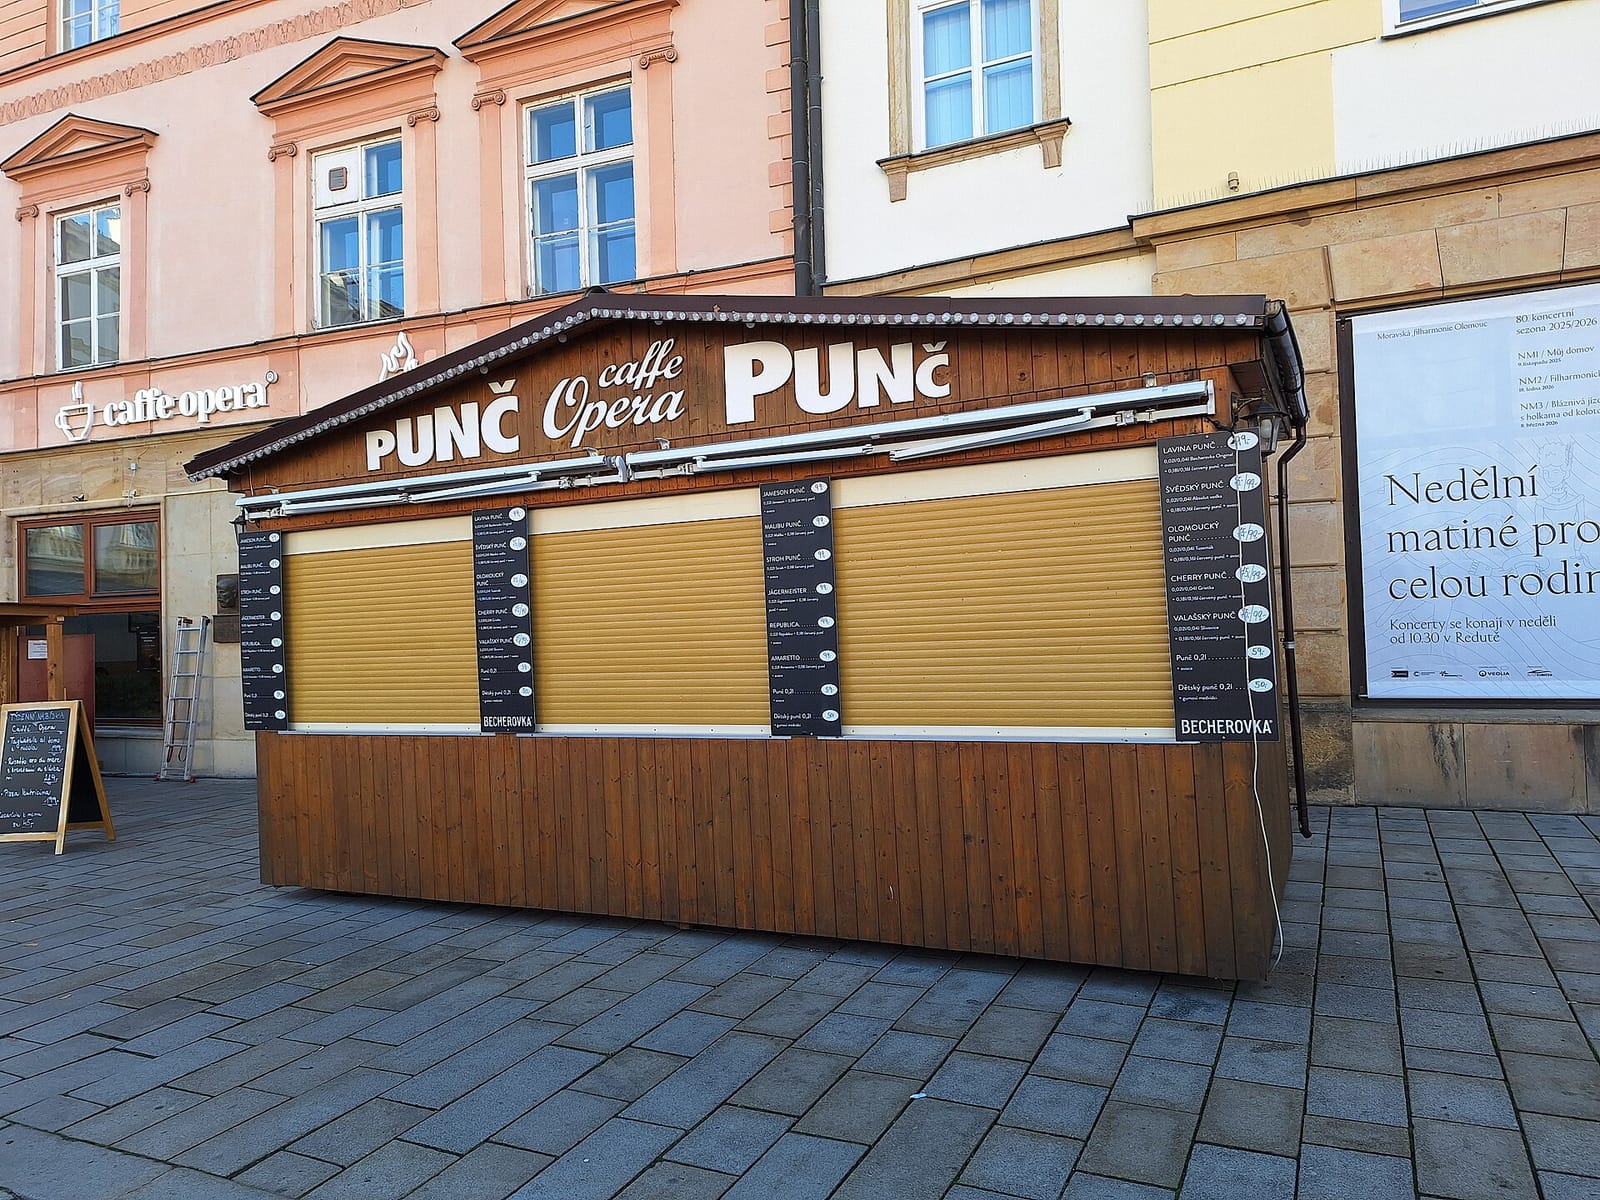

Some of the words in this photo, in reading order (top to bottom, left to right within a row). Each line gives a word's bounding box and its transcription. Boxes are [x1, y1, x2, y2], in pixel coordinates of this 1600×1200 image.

[1531, 308, 1575, 322] koncertní
[1377, 330, 1411, 340] Moravská
[1454, 321, 1489, 331] Olomouc
[1516, 325, 1546, 335] sezona
[1549, 317, 1598, 331] 2025/2026
[1566, 345, 1595, 355] domov
[598, 338, 684, 391] caffe
[723, 340, 951, 425] PUNČ
[1519, 376, 1542, 386] NM2
[103, 388, 177, 427] caffe
[1520, 402, 1543, 411] NM3
[1551, 398, 1585, 409] Bláznivá
[542, 376, 685, 448] Opera
[1526, 411, 1561, 421] holkama
[1562, 409, 1574, 418] od
[365, 379, 520, 472] PUNČ
[1163, 445, 1192, 454] LAVINA
[1193, 441, 1216, 450] PUNČ
[1165, 482, 1200, 494] ŠVÉDSKÝ
[1201, 480, 1224, 490] PUNČ
[1383, 464, 1538, 505] Nedělní
[763, 489, 789, 498] JAMESON
[790, 486, 806, 495] PUNČ
[764, 522, 785, 530] MALIBU
[785, 520, 802, 529] PUNČ
[1167, 521, 1220, 533] OLOMOUCKÝ
[1168, 533, 1191, 543] PUNČ
[1387, 515, 1519, 553] matiné
[1533, 520, 1600, 557] pro
[785, 553, 802, 561] PUNČ
[1171, 573, 1203, 582] CHERRY
[1204, 571, 1227, 580] PUNČ
[1388, 566, 1488, 600] celou
[1173, 611, 1212, 622] VALAŠSKÝ
[1213, 611, 1236, 620] PUNČ
[1390, 618, 1445, 632] Koncerty
[1450, 620, 1462, 629] se
[1465, 617, 1503, 630] konají
[1519, 615, 1556, 628] neděli
[1390, 633, 1406, 644] od
[1410, 633, 1440, 644] 10.30
[1443, 635, 1452, 643] v
[1455, 631, 1500, 643] Redutě
[1193, 653, 1207, 662] 0,2l
[1178, 683, 1202, 692] Dětský
[1219, 683, 1233, 691] 0,2l
[483, 716, 533, 727] BECHEROVKA
[1181, 719, 1272, 734] BECHEROVKA
